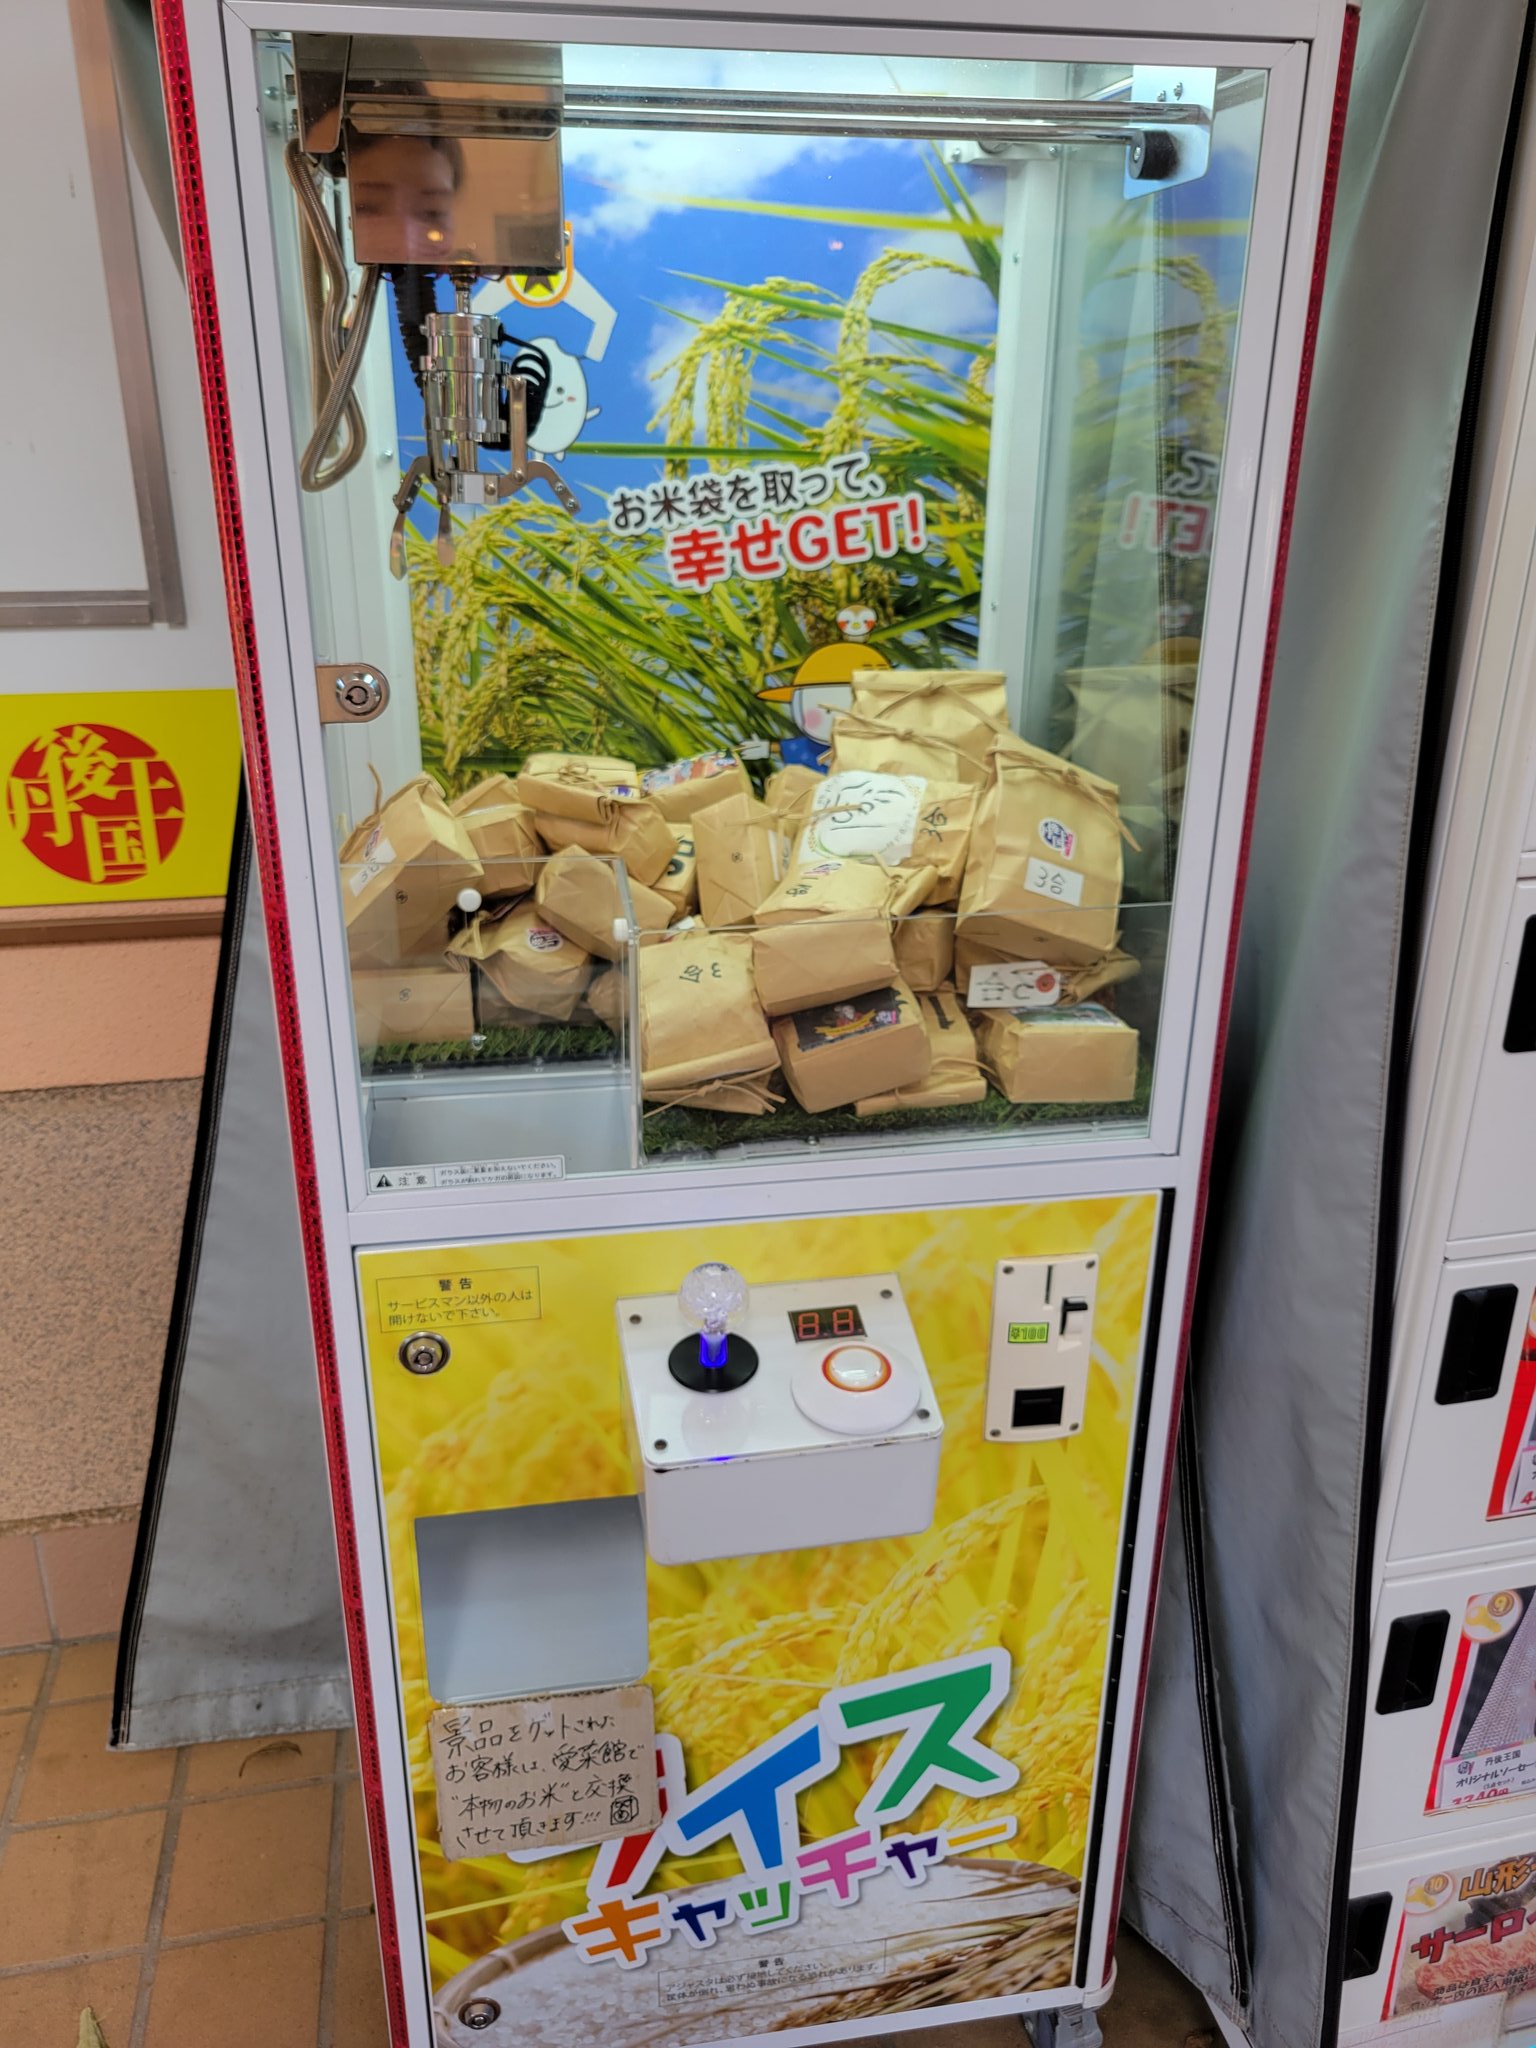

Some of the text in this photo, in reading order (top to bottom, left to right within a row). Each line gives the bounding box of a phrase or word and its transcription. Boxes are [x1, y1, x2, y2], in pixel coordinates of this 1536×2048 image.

[613, 457, 881, 529] お米袋を取って、
[671, 498, 922, 587] 幸せGET!
[398, 1175, 428, 1187] 注意
[388, 1289, 532, 1312] サービスマン以外の人は
[438, 1277, 473, 1292] 警告
[388, 1306, 501, 1327] 開けないで下さい。
[440, 1711, 616, 1760] 景品をゲットされた
[573, 1823, 1007, 1963] キャッチャー
[1459, 1856, 1536, 1902] 山形
[757, 1957, 785, 1969] 警告
